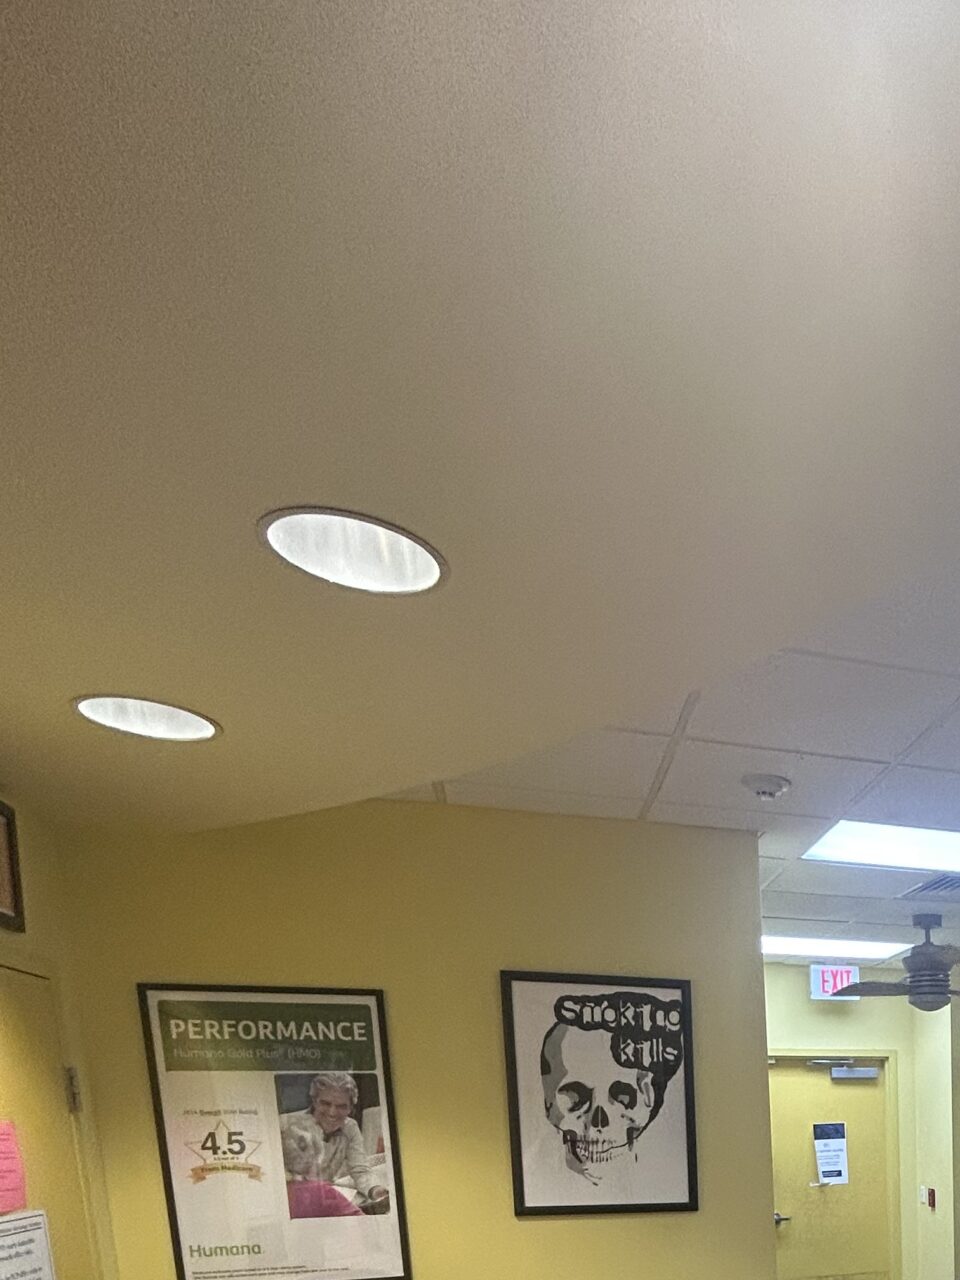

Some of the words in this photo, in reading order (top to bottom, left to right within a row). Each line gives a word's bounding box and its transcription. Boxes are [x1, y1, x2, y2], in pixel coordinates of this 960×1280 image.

[821, 969, 852, 993] EXIT
[169, 1018, 368, 1041] PERFORMANCE
[200, 1131, 247, 1156] 4.5
[188, 1244, 262, 1258] Humana
